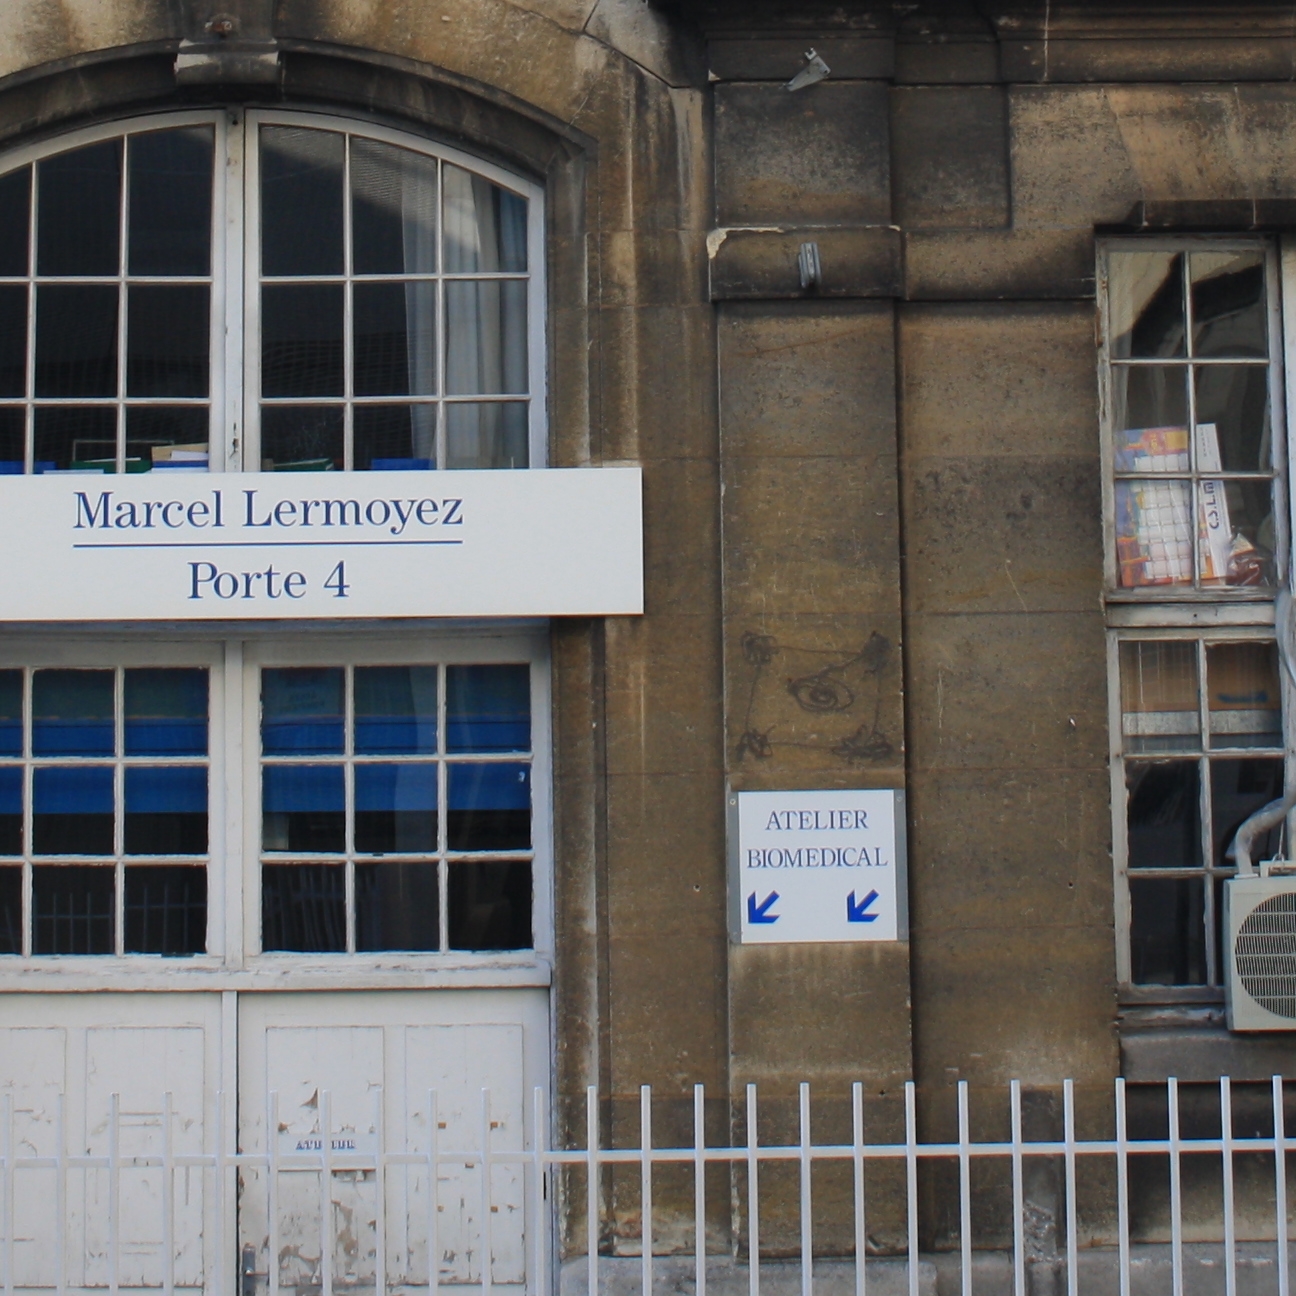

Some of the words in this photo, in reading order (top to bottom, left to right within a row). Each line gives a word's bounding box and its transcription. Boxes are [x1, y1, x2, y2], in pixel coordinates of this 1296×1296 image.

[73, 489, 226, 529] Marcel
[241, 489, 463, 534] Lermoyez
[187, 560, 307, 599] Porte
[323, 559, 350, 598] 4
[766, 810, 868, 830] ATELIER
[747, 847, 888, 869] BIOMEDICAL
[296, 1140, 355, 1150] ATEIER
